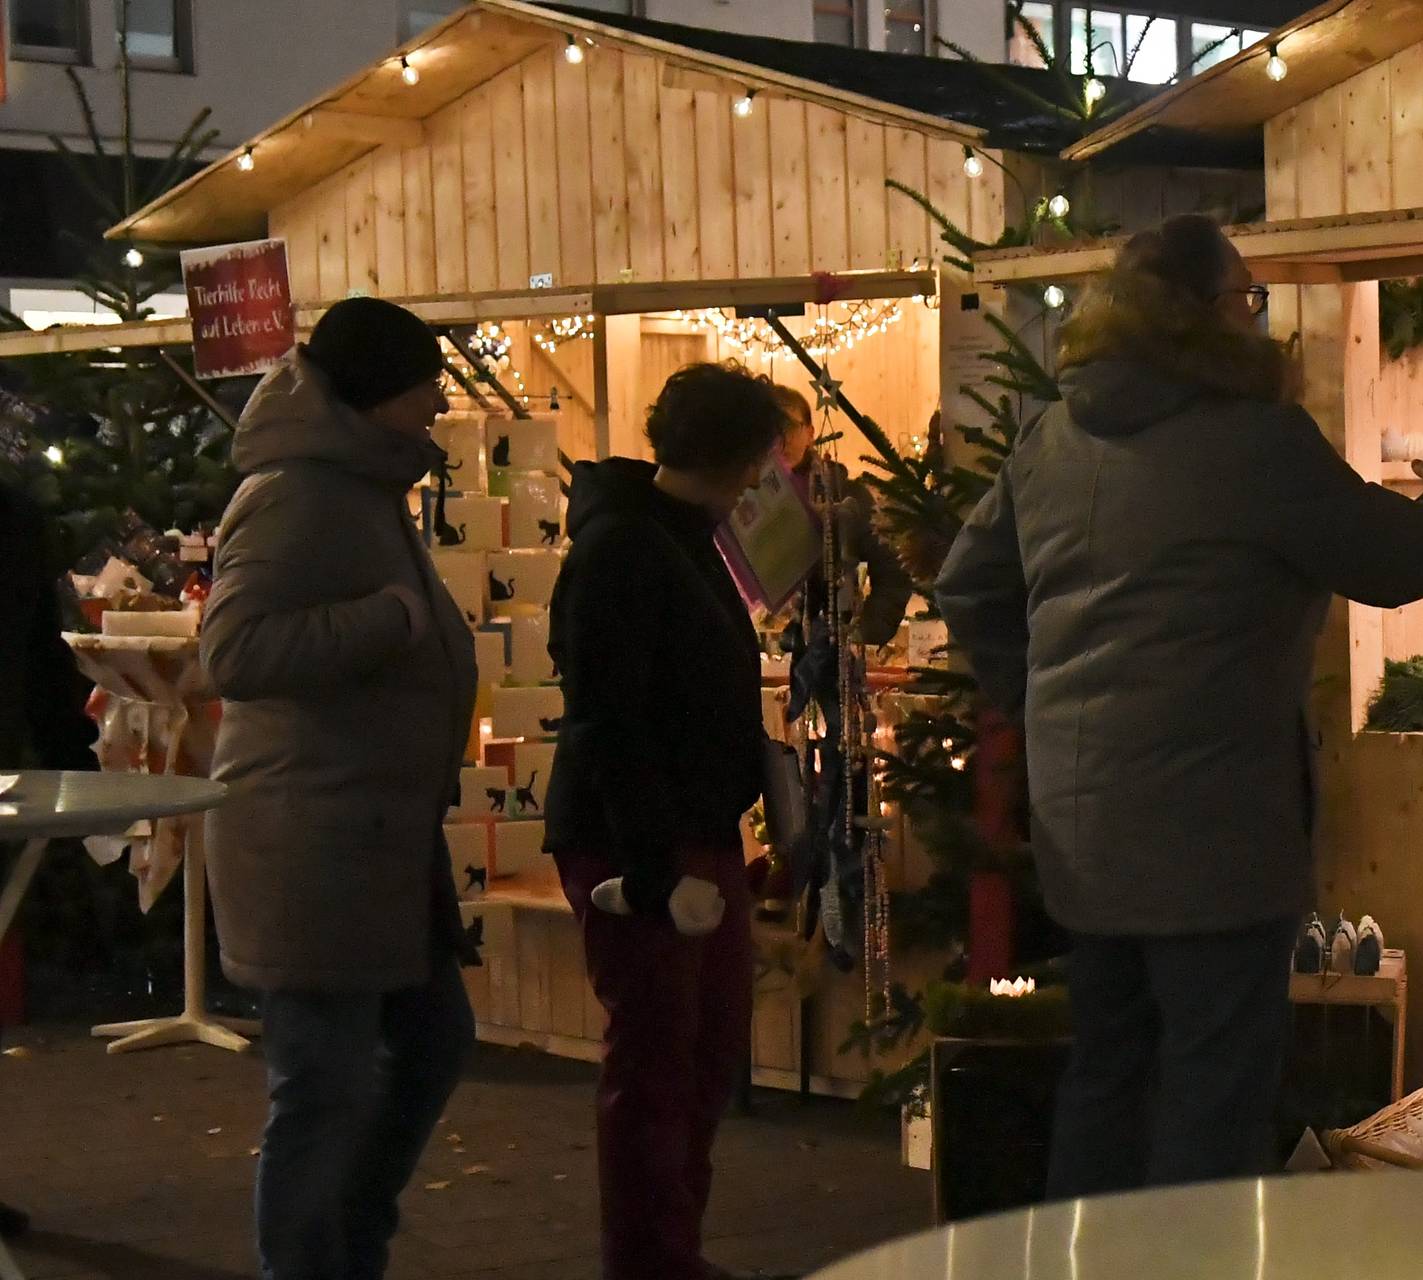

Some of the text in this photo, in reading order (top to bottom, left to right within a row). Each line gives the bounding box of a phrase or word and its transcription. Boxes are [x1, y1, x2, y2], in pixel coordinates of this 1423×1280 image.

[193, 278, 282, 305] Tierhilfe Recht
[202, 316, 220, 339] auf
[223, 312, 261, 336] Leben
